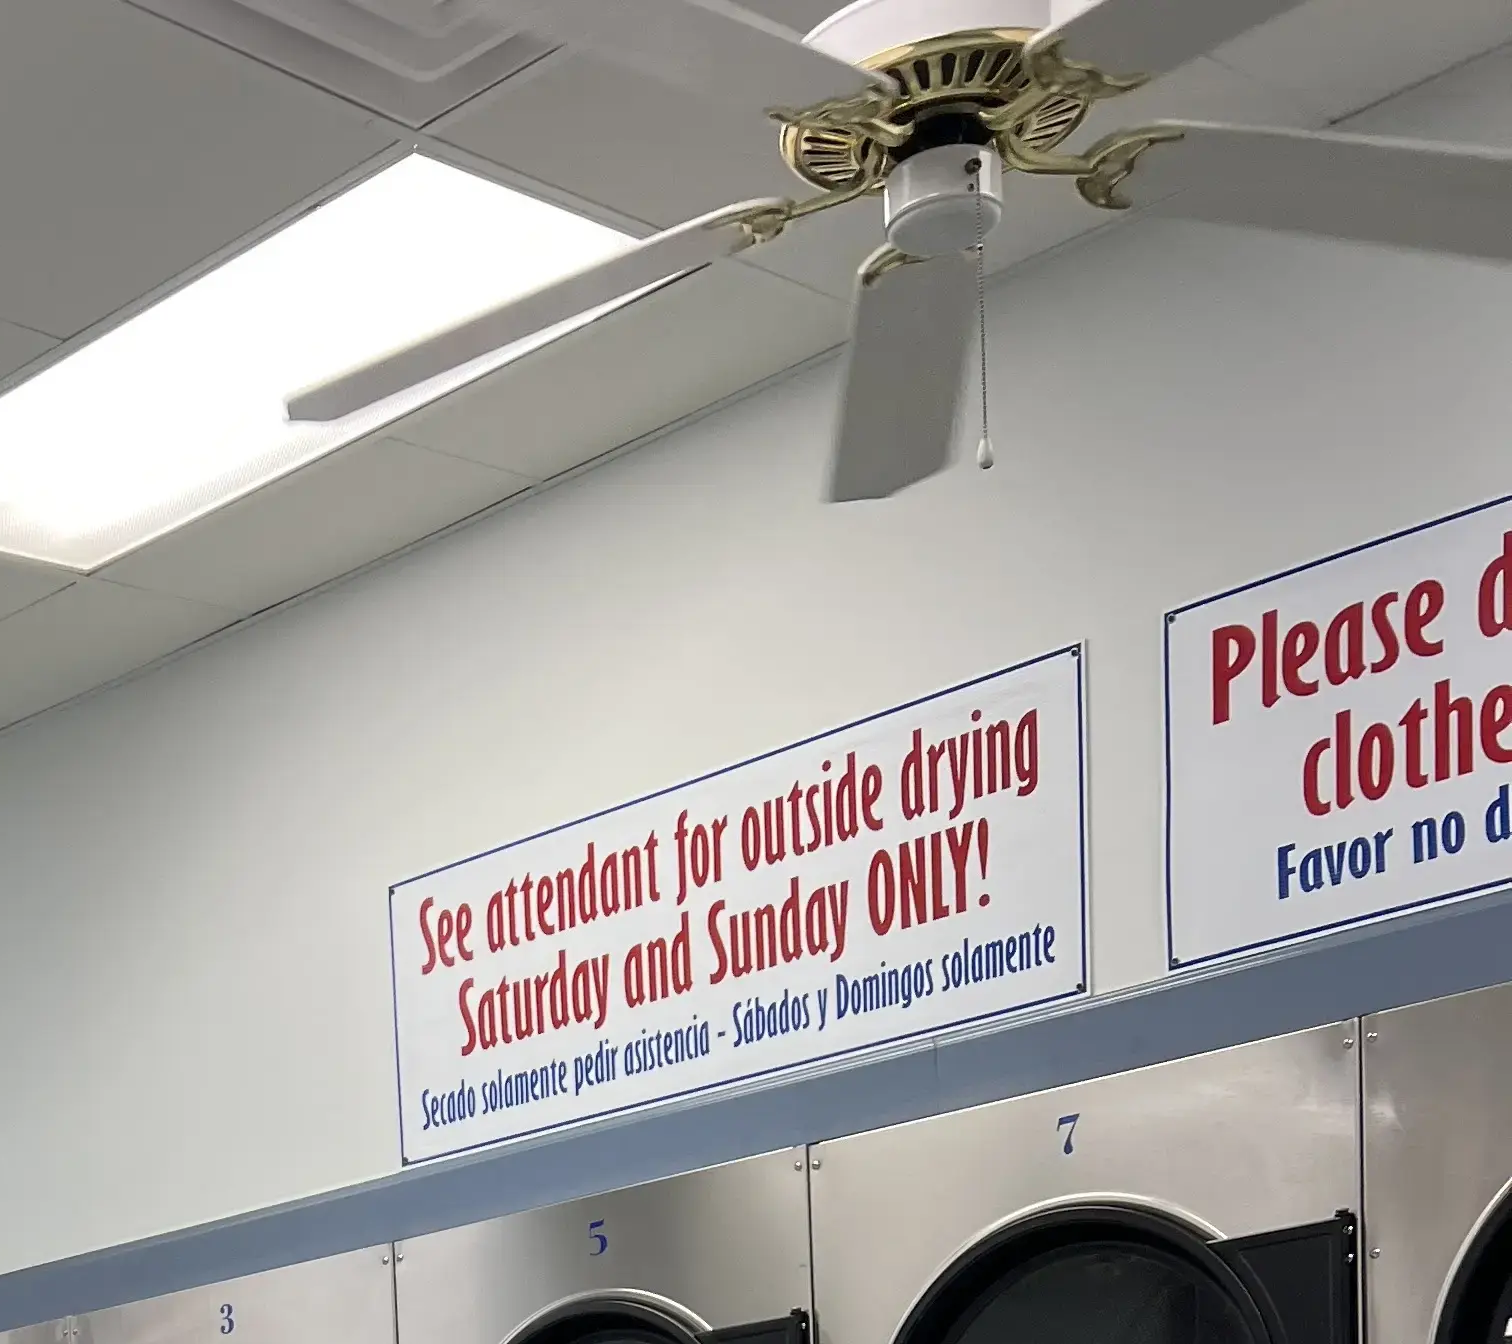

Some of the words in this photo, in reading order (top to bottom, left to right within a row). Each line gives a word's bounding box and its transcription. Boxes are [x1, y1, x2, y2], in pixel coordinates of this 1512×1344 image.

[1211, 578, 1445, 726] Please
[419, 897, 474, 976] See
[486, 834, 661, 953] attendant
[674, 810, 728, 907] for
[740, 752, 885, 872] outside
[901, 709, 1039, 820] drying
[1277, 828, 1393, 900] Favor
[1411, 811, 1465, 864] no
[458, 950, 610, 1057] Saturday
[623, 910, 694, 1009] and
[706, 877, 850, 985] Sunday
[867, 818, 990, 936] ONLY!
[421, 1089, 476, 1131] Secado
[481, 1061, 569, 1114] solamente
[573, 1044, 619, 1094] pedir
[624, 1014, 710, 1076] asistencia
[732, 997, 811, 1048] Sábados
[817, 989, 828, 1031] y
[835, 957, 934, 1020] Domingos
[941, 924, 1056, 991] solamente
[1056, 1114, 1080, 1155] 7
[588, 1218, 609, 1256] 5
[220, 1303, 235, 1334] 3
